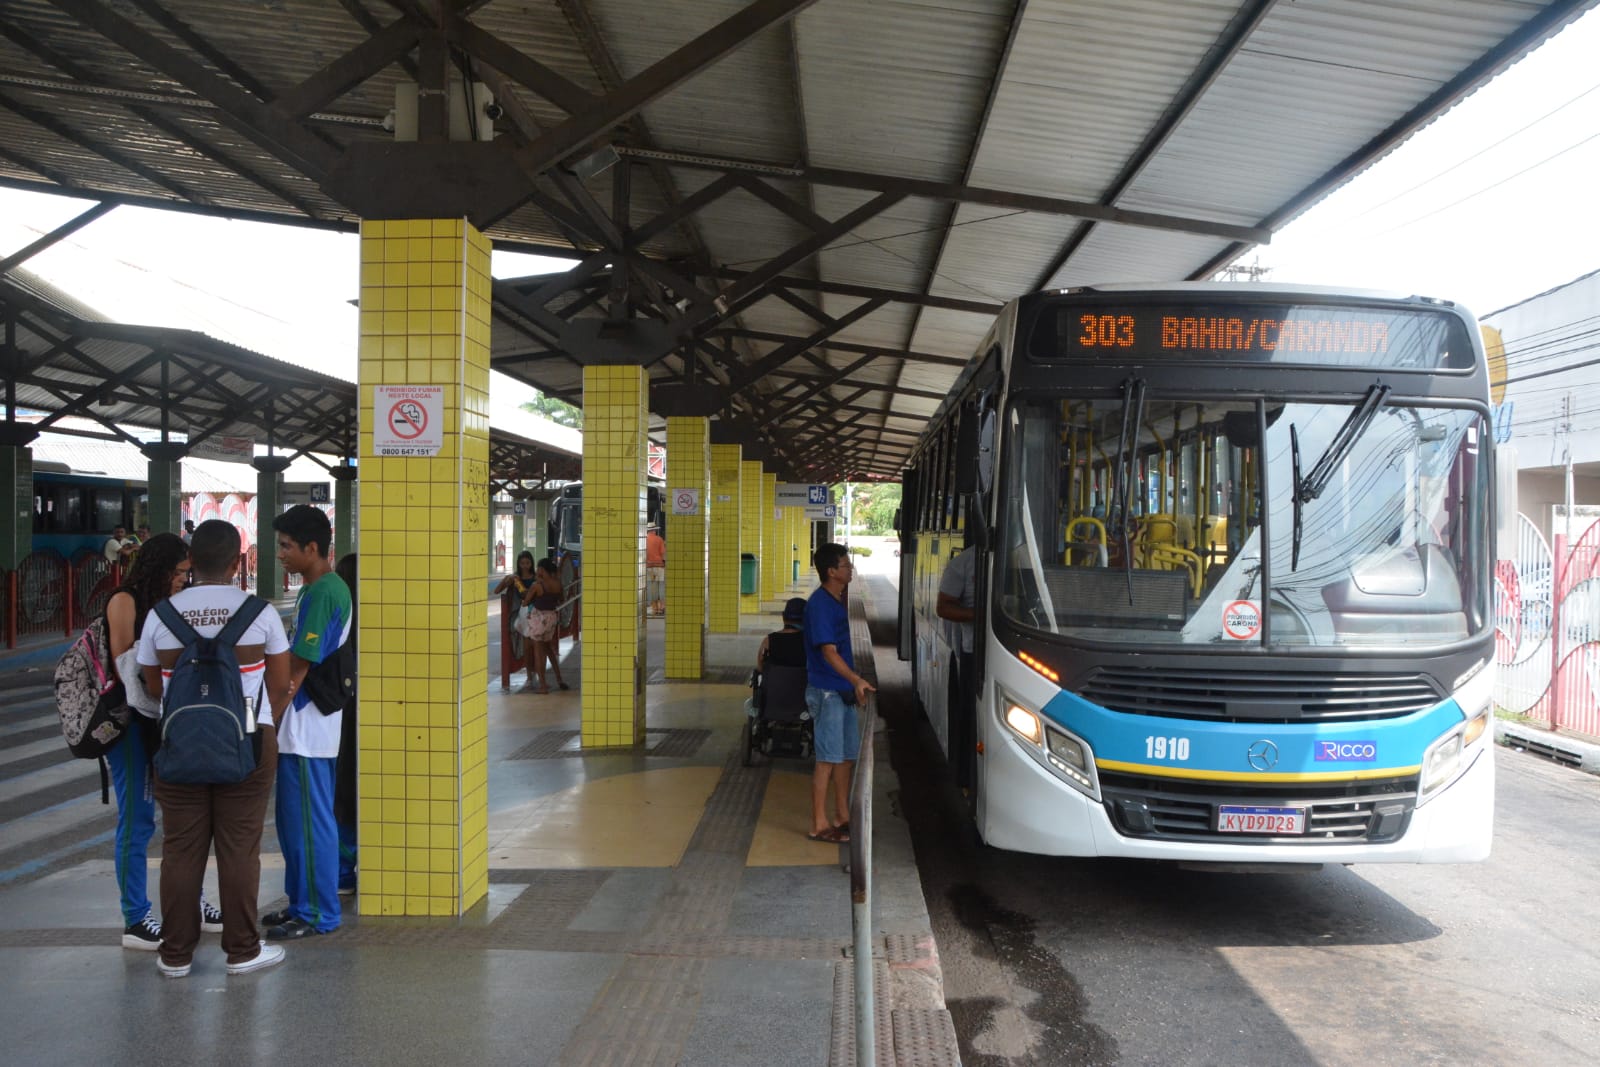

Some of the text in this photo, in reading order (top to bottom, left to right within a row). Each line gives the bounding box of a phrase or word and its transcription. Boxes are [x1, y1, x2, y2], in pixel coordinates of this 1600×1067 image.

[1079, 315, 1389, 353] 303 BAHIA/CARANDA
[182, 606, 230, 618] COLÉGIO
[1145, 736, 1190, 760] 1910
[1226, 815, 1295, 832] KYD9D28
